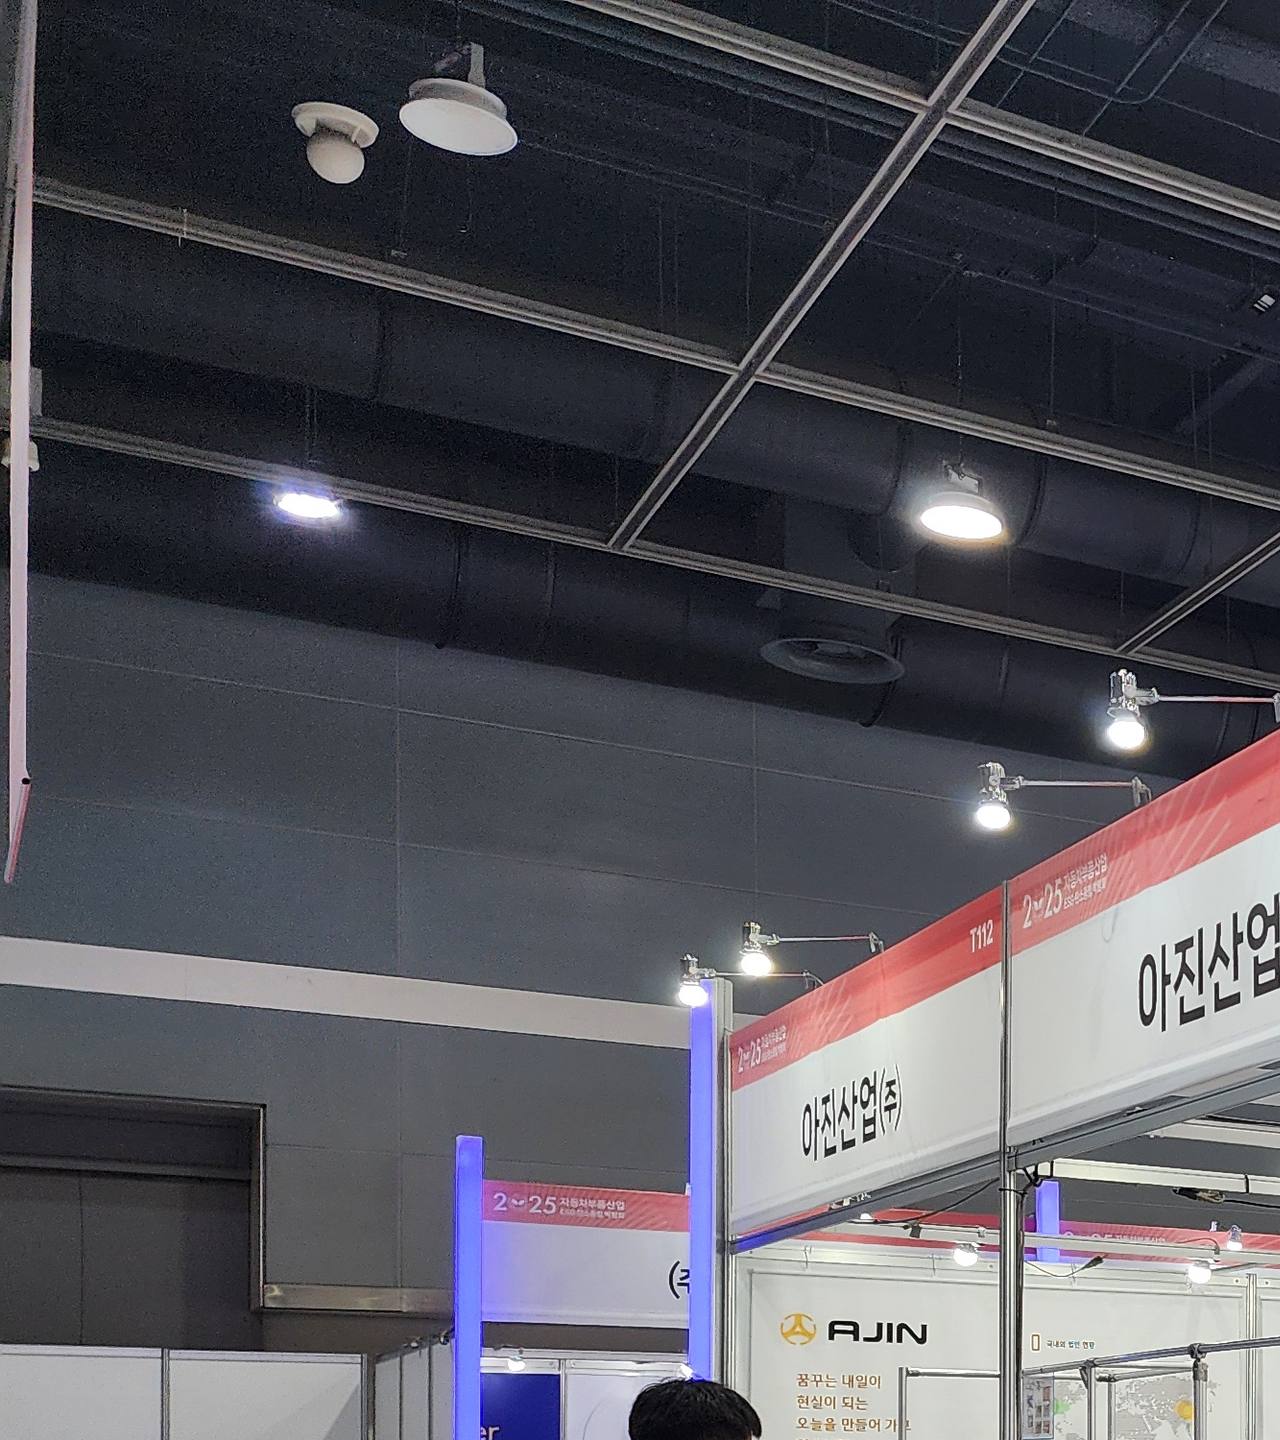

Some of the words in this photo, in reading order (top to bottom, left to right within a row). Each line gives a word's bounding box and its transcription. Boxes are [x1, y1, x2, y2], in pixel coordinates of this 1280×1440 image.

[970, 919, 993, 952] T112
[802, 1064, 903, 1161] 아진산업(주)
[828, 1320, 927, 1345] AJIN
[796, 1373, 837, 1388] 꿈꾸는
[841, 1374, 881, 1389] 내일이
[796, 1395, 836, 1410] 현실이
[841, 1396, 868, 1410] 되는
[796, 1417, 836, 1431] 오늘을
[841, 1418, 881, 1432] 만들어
